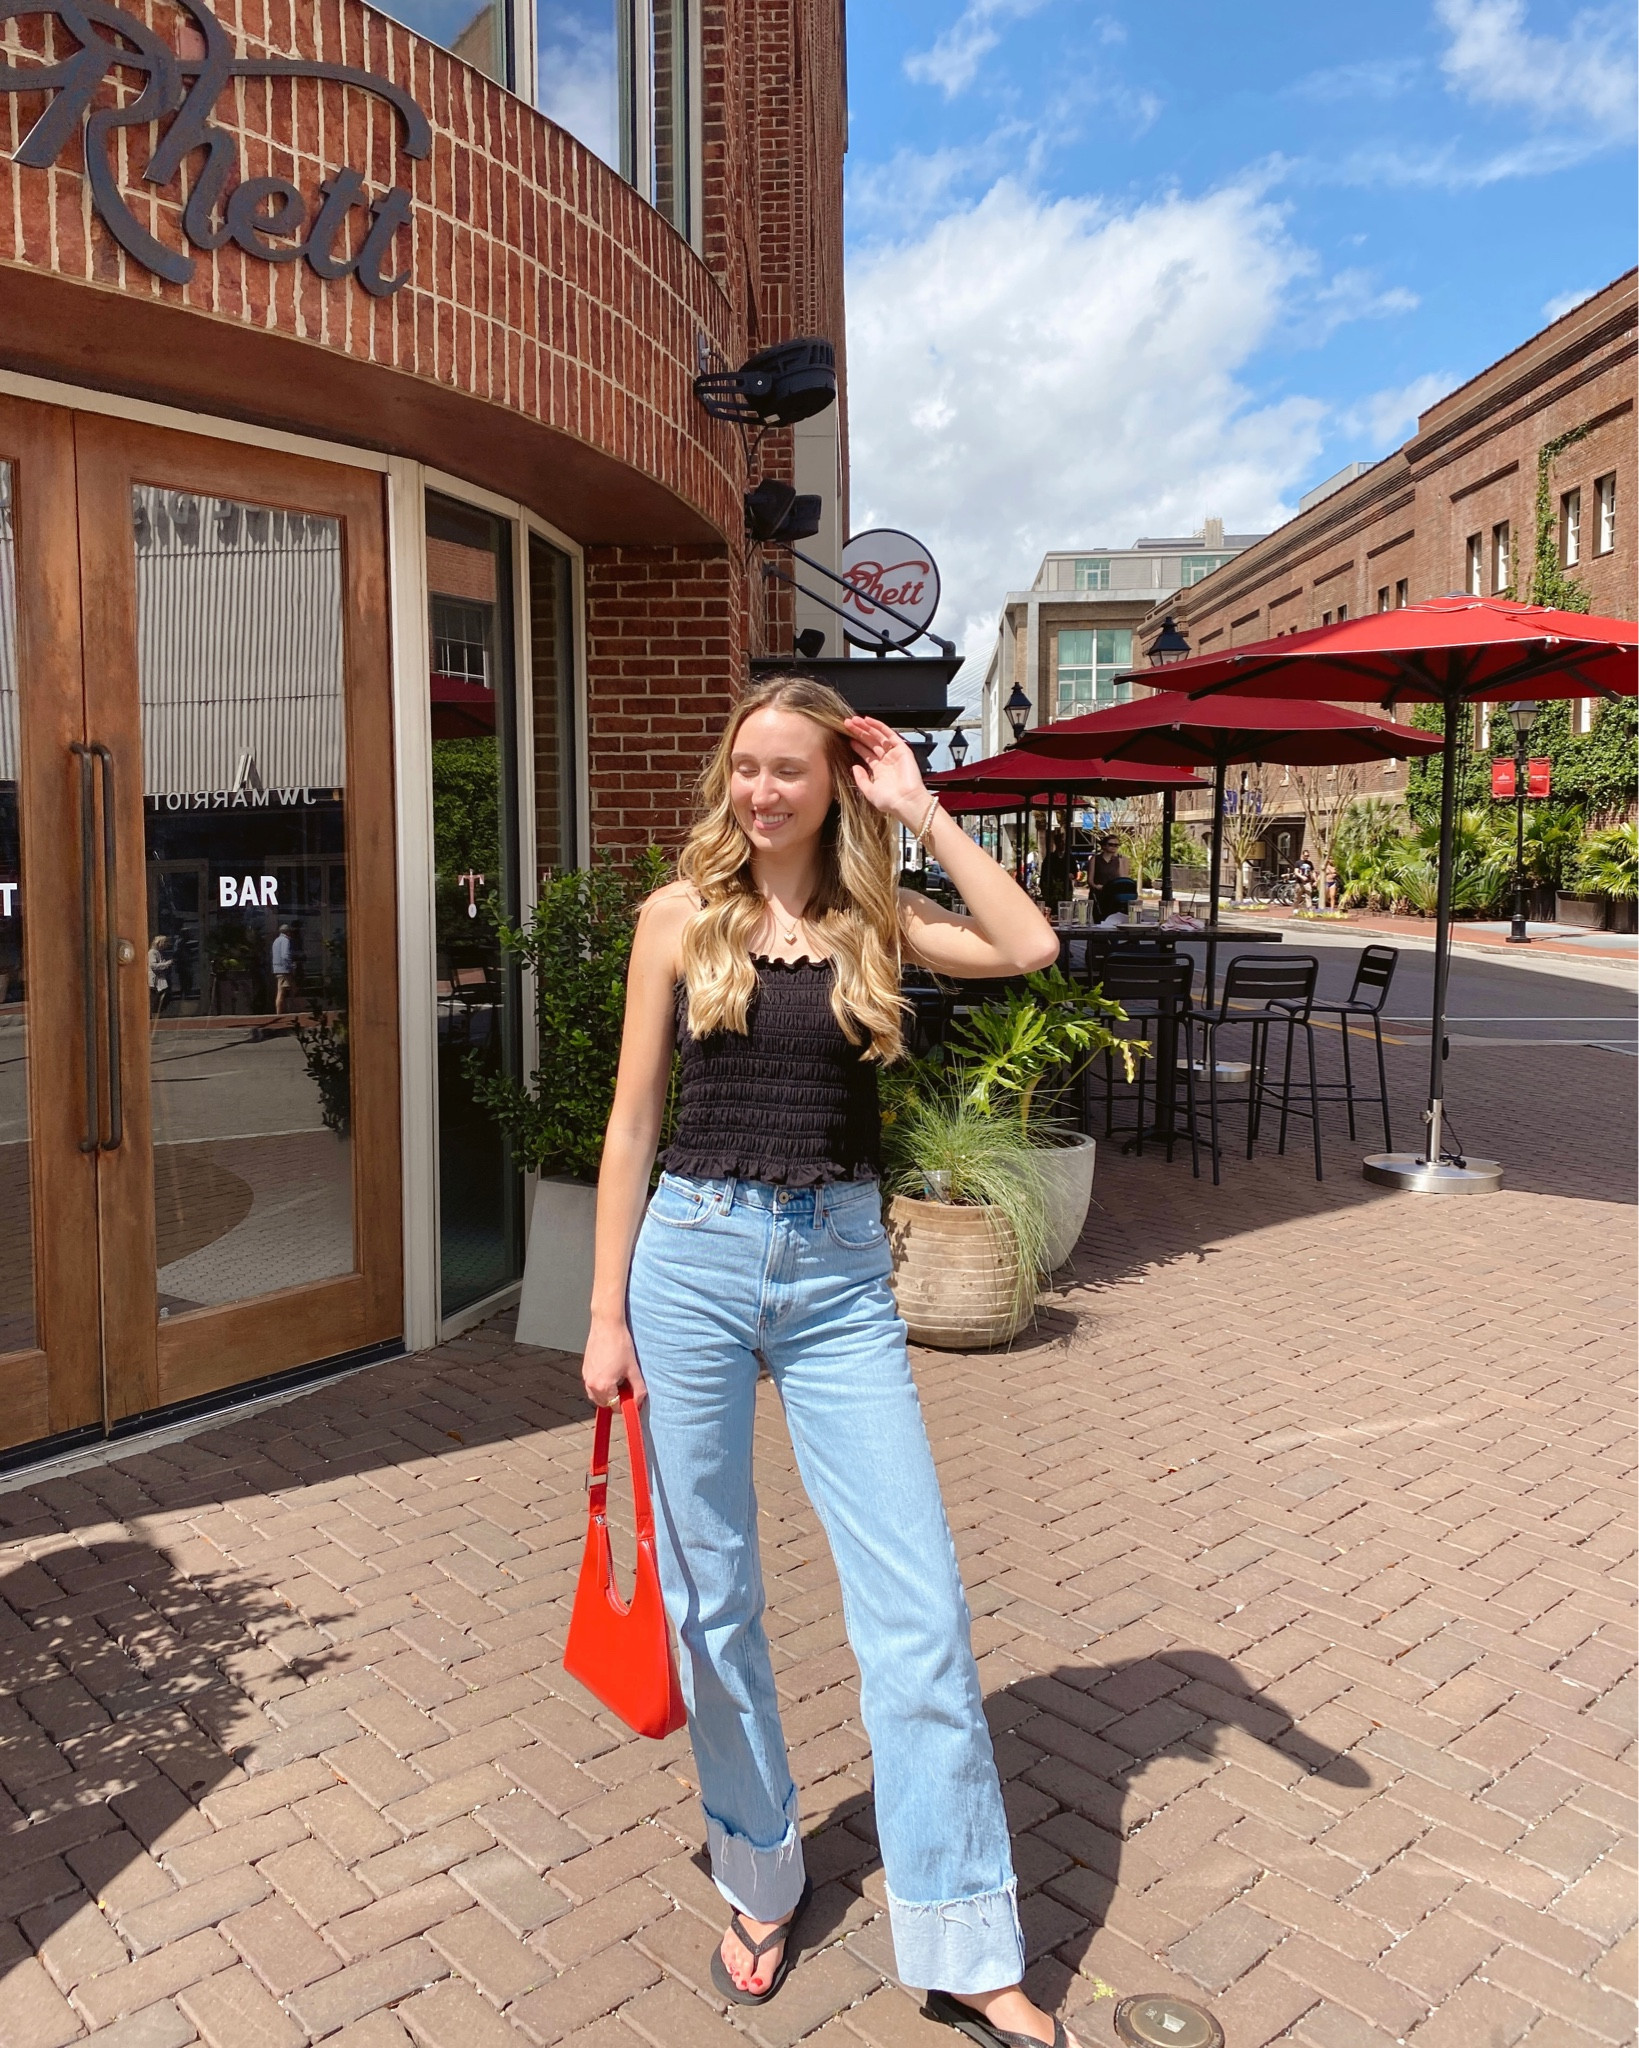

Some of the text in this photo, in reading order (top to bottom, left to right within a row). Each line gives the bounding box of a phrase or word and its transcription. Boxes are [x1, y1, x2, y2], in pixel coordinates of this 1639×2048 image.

[0, 0, 432, 298] Rhett
[842, 560, 931, 615] Rhett
[219, 875, 279, 907] BAR
